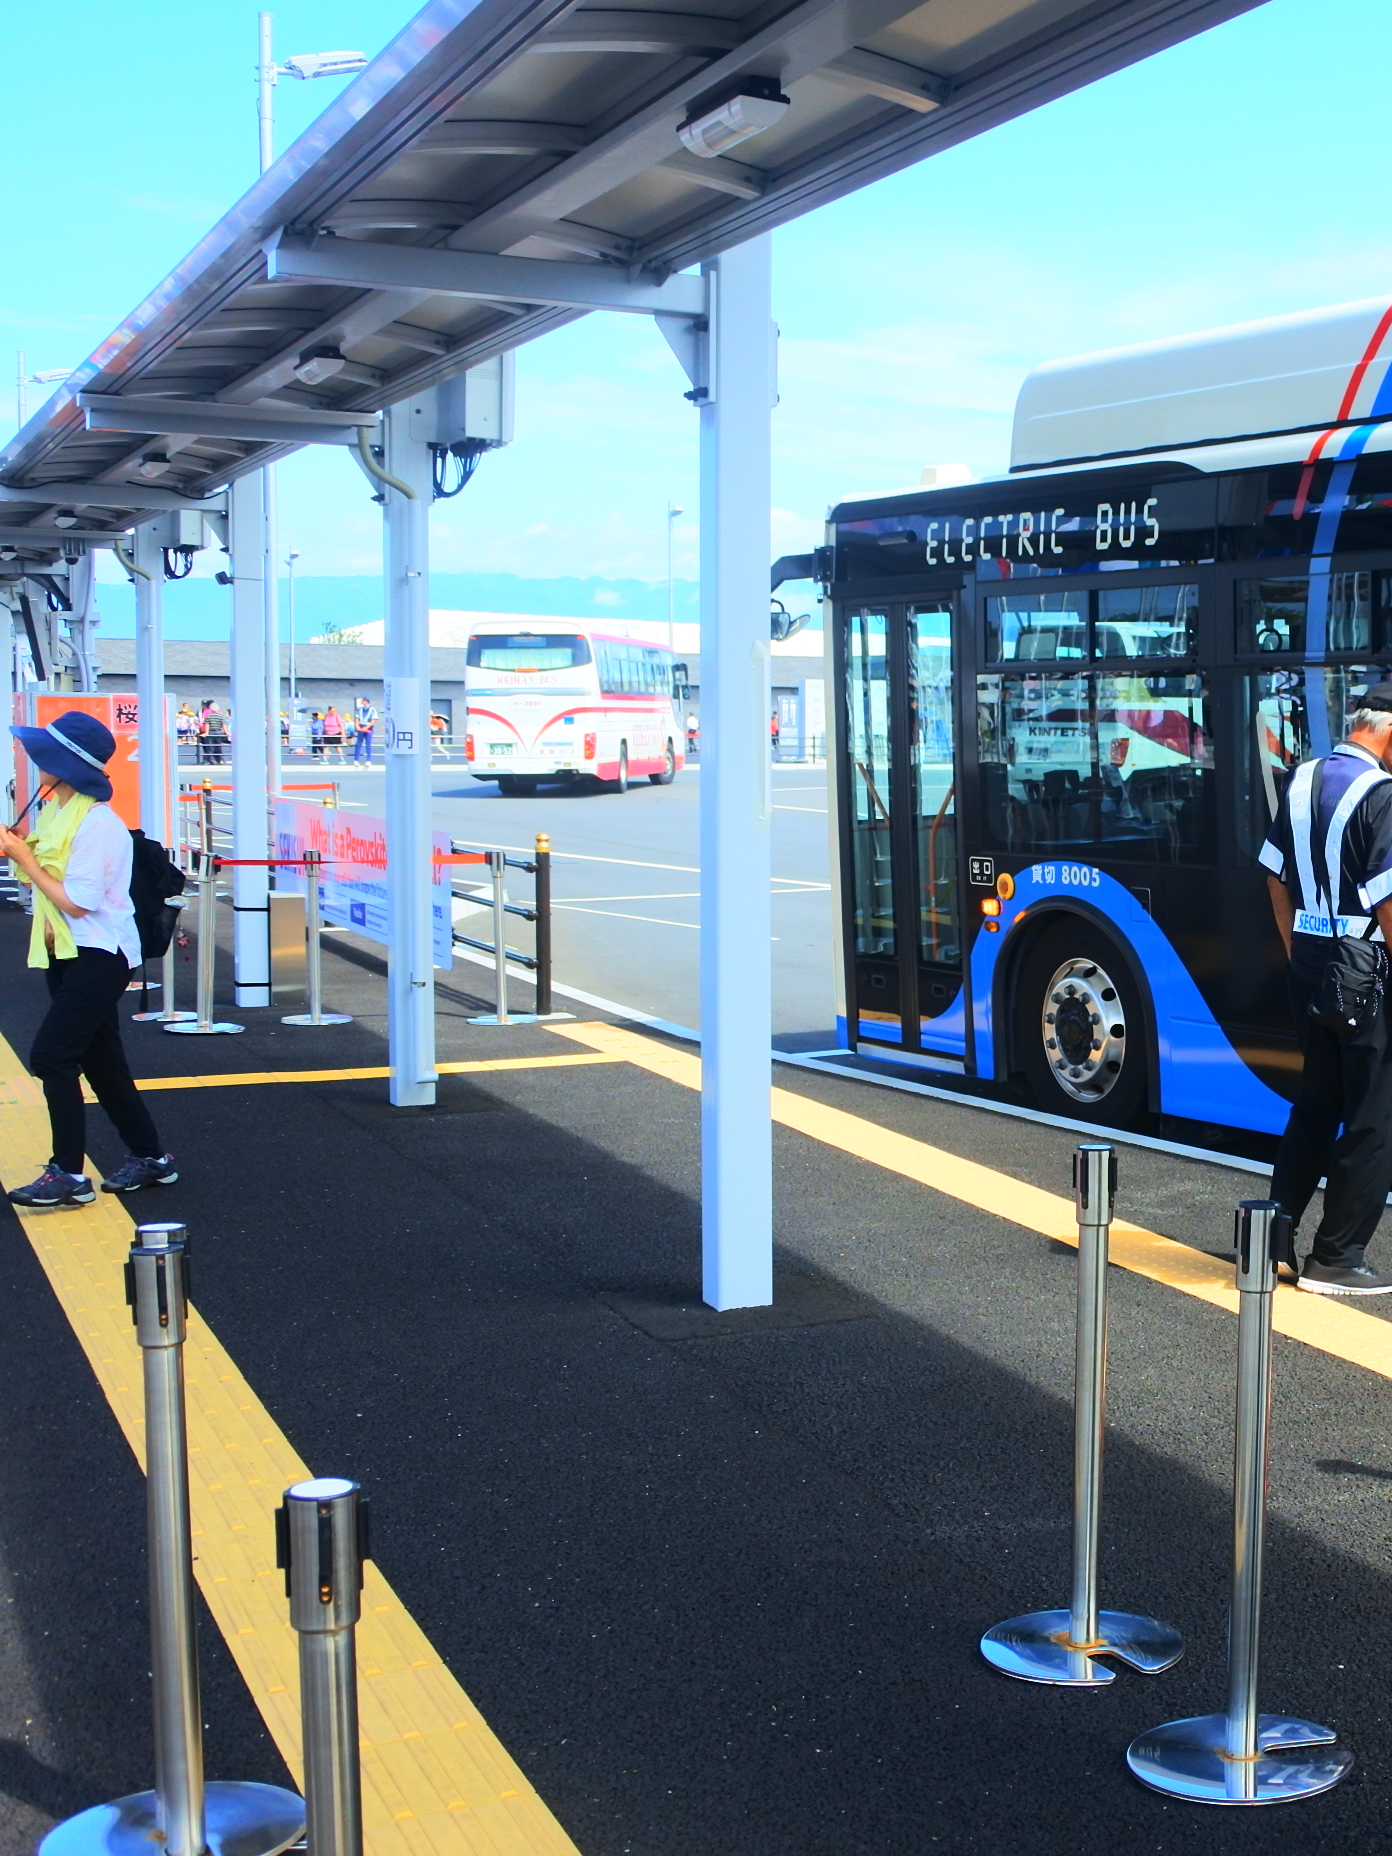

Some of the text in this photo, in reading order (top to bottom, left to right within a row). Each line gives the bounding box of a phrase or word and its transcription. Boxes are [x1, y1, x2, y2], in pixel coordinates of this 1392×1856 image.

[926, 497, 1159, 565] ELECTRIC BUS
[497, 675, 558, 685] KEIHAN BUS
[1028, 726, 1088, 738] KINTETS
[309, 818, 331, 855] What
[345, 826, 388, 871] Perovskit
[972, 860, 991, 875] 出口
[1031, 864, 1100, 887] 貸切 8005
[1297, 913, 1350, 935] SECURITY
